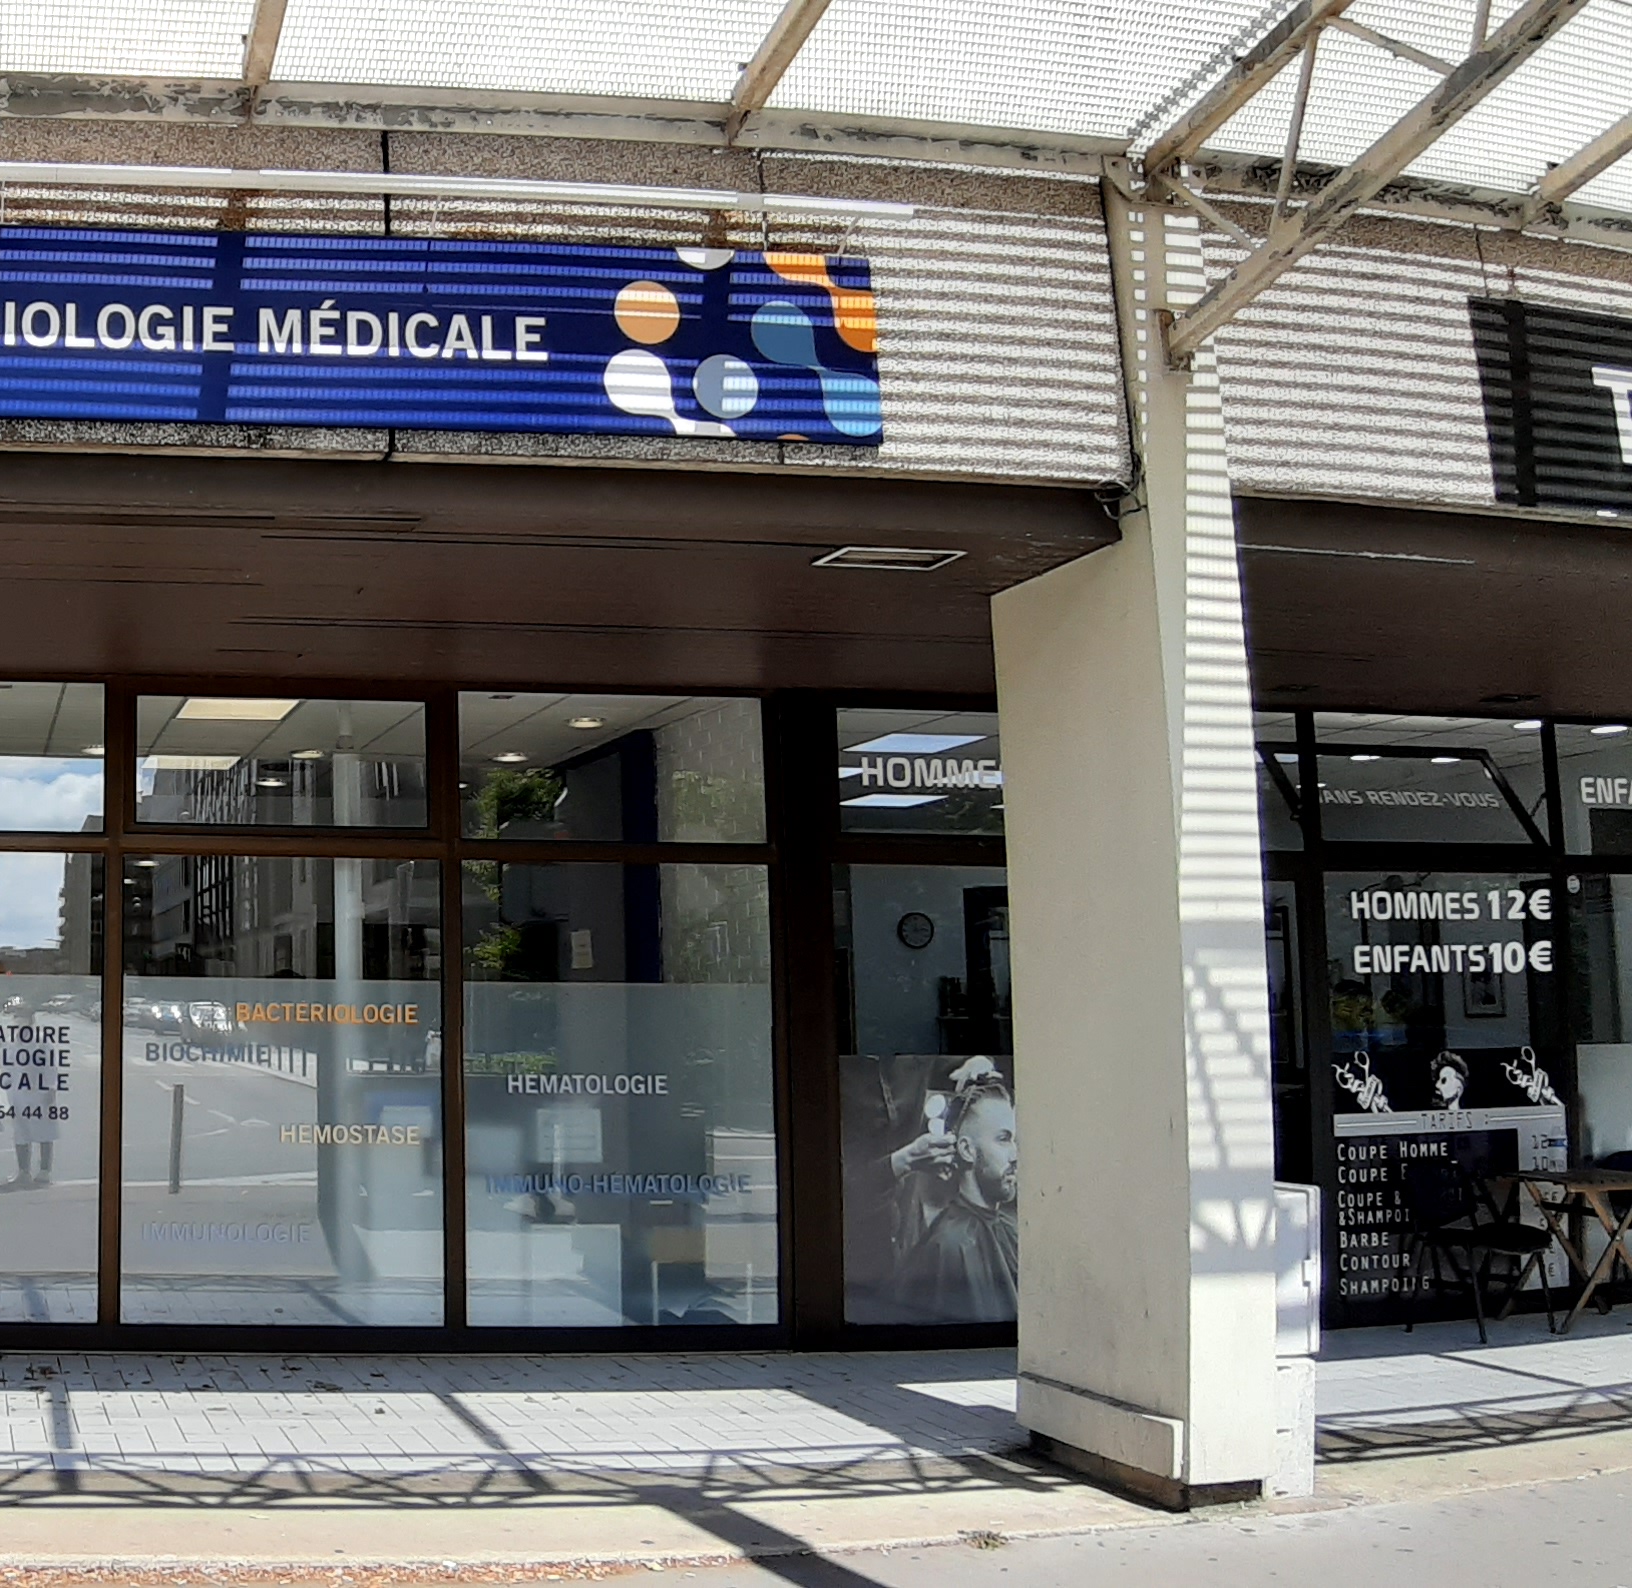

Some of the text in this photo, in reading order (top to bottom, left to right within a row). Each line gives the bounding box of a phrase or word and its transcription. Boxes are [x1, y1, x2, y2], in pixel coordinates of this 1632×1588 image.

[258, 300, 548, 361] MÉDICALE
[861, 757, 1003, 788] HOMME
[1318, 789, 1500, 808] ANS RENDEZ-VOUS
[1351, 889, 1552, 920] HOMMES 12€
[1353, 941, 1552, 973] ENFANTS 10€
[145, 1042, 271, 1064] BIOCHIMIE
[22, 1106, 42, 1119] 44
[48, 1106, 69, 1120] 88
[1421, 1112, 1473, 1130] TARIFS
[1339, 1209, 1410, 1225] &SHAMPOI
[141, 1221, 312, 1243] IMMUNOLOGIE
